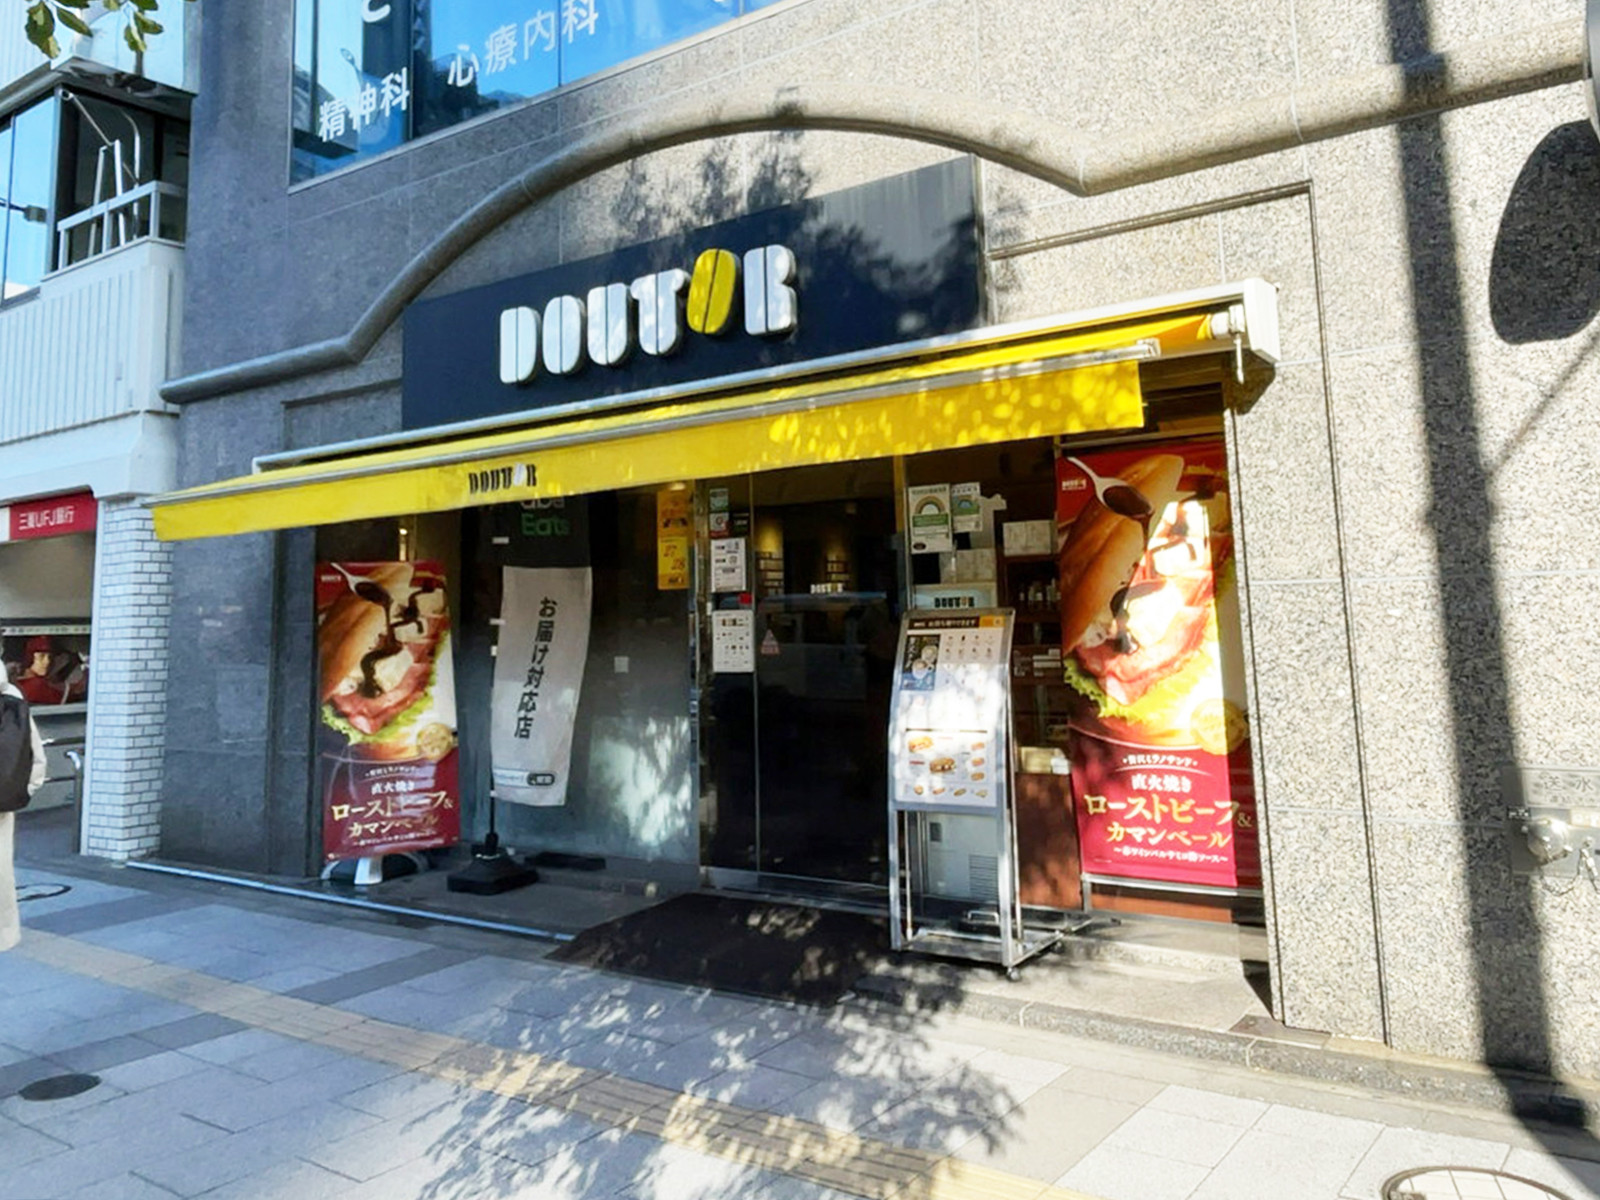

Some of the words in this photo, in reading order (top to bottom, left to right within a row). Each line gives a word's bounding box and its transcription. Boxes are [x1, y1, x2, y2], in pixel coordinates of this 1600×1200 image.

[318, 67, 411, 142] 精神科
[447, 0, 599, 88] 心療内科
[499, 244, 797, 385] DOUTOR
[468, 463, 537, 495] DOUTOR
[521, 513, 570, 536] Eats
[934, 596, 975, 609] DOUTOR
[514, 596, 558, 740] お届け対応店
[1131, 772, 1192, 793] 直火焼き
[1106, 821, 1233, 849] カマンベール
